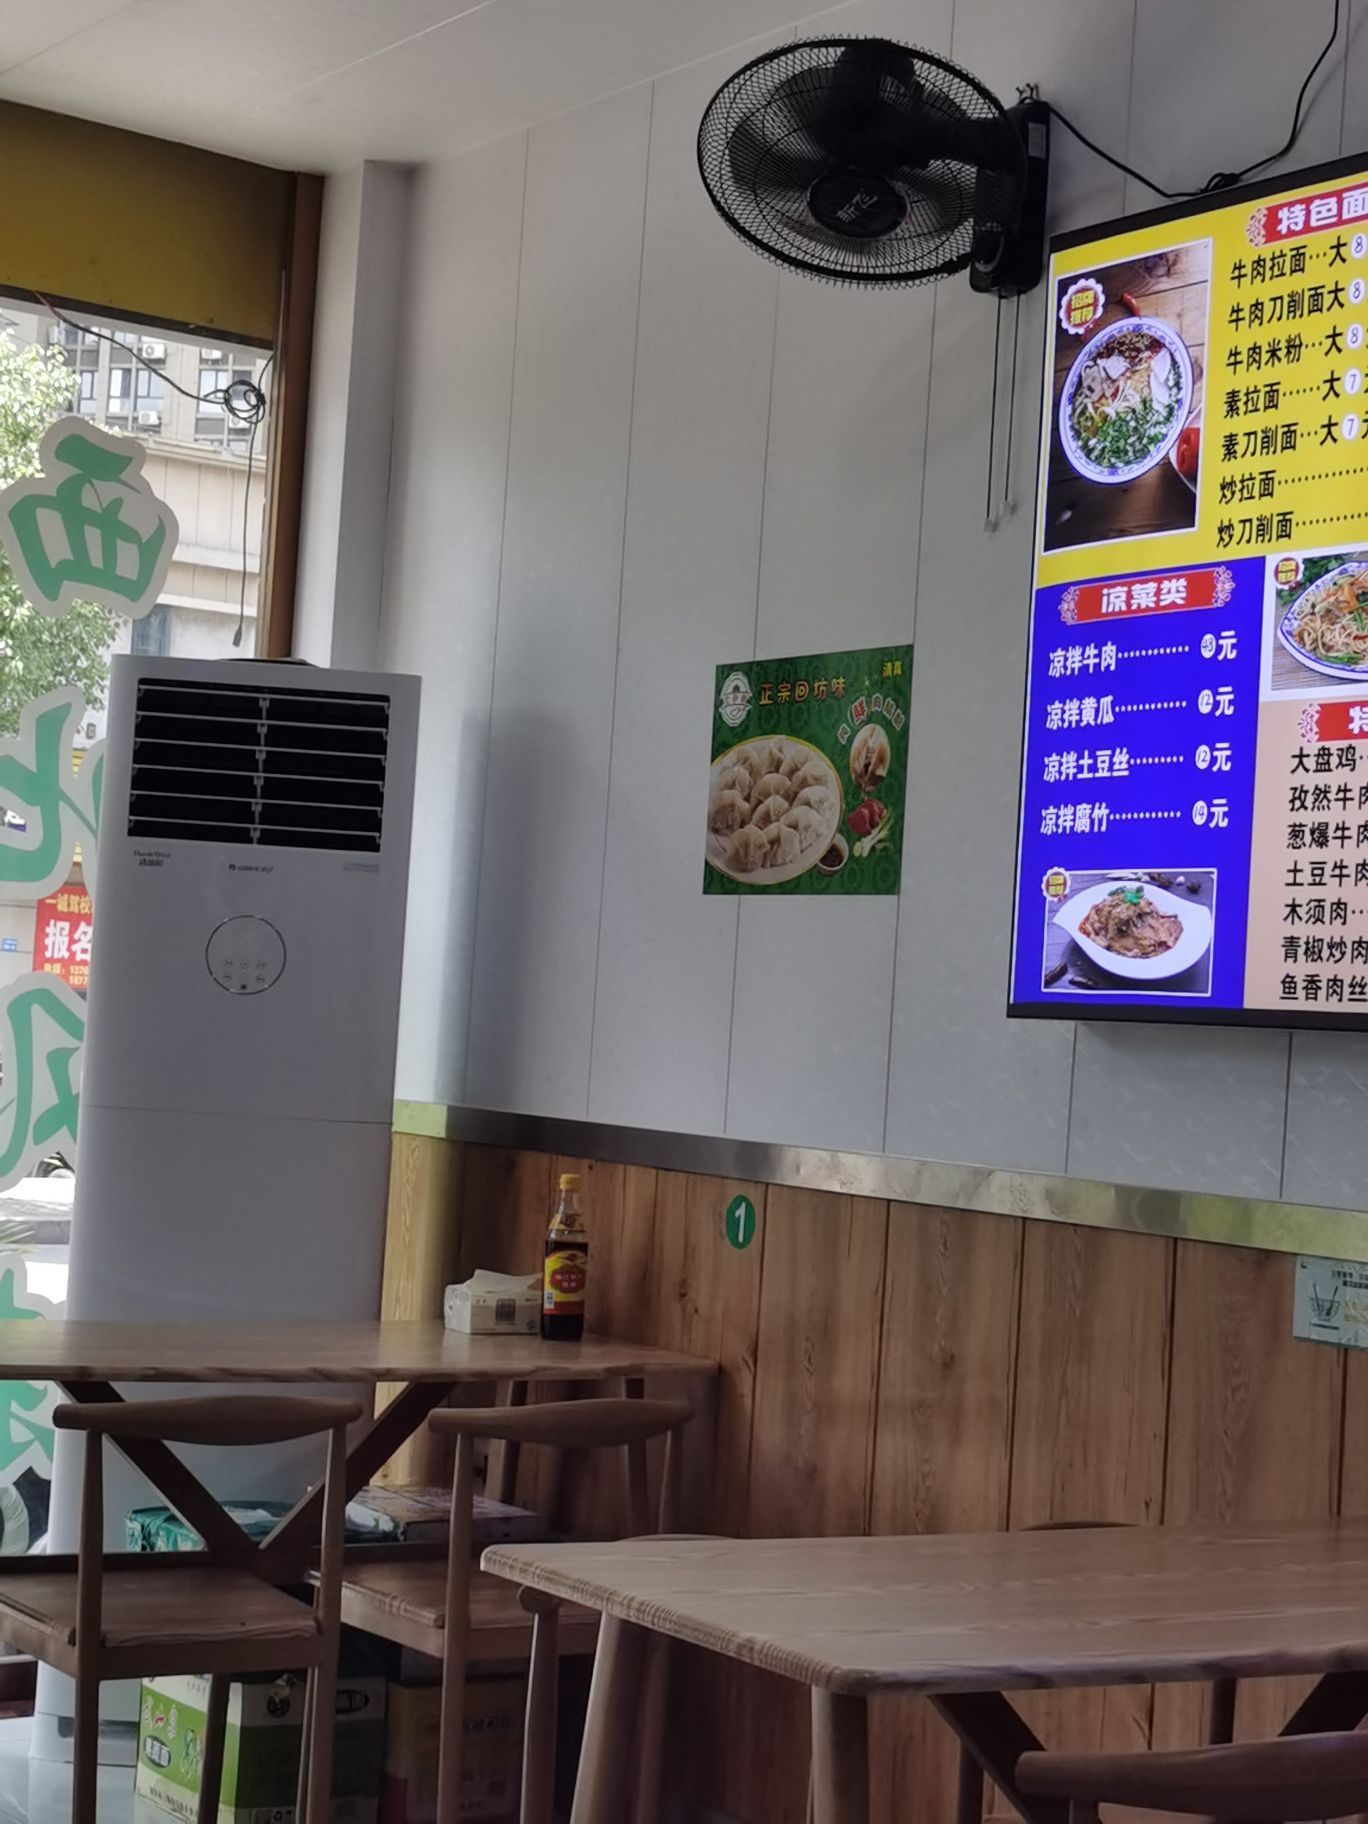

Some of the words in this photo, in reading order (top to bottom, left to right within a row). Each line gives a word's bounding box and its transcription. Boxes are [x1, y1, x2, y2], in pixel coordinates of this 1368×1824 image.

[1277, 187, 1368, 234] 特色面
[1231, 245, 1307, 288] 牛肉拉面
[1226, 332, 1302, 375] 牛肉米粉
[1224, 382, 1281, 419] 素拉面
[1221, 422, 1299, 462] 素刀削面
[1219, 470, 1276, 505] 炒拉面
[1216, 511, 1294, 548] 炒刀削面
[1101, 578, 1187, 613] 凉菜类
[1048, 641, 1117, 678] 凉拌牛肉
[1046, 695, 1115, 730] 凉拌黄瓜
[1043, 747, 1130, 783] 凉拌土豆丝
[1290, 744, 1357, 774] 大盘鸡
[1040, 802, 1110, 835] 凉拌腐竹
[1287, 820, 1368, 849] 葱爆牛肉
[1285, 859, 1368, 887] 土豆牛肉
[1283, 897, 1347, 926] 木须肉
[45, 919, 92, 962] 报名
[1281, 935, 1368, 964] 青椒炒肉
[1280, 973, 1368, 1002] 鱼香肉丝
[735, 1202, 747, 1243] 1
